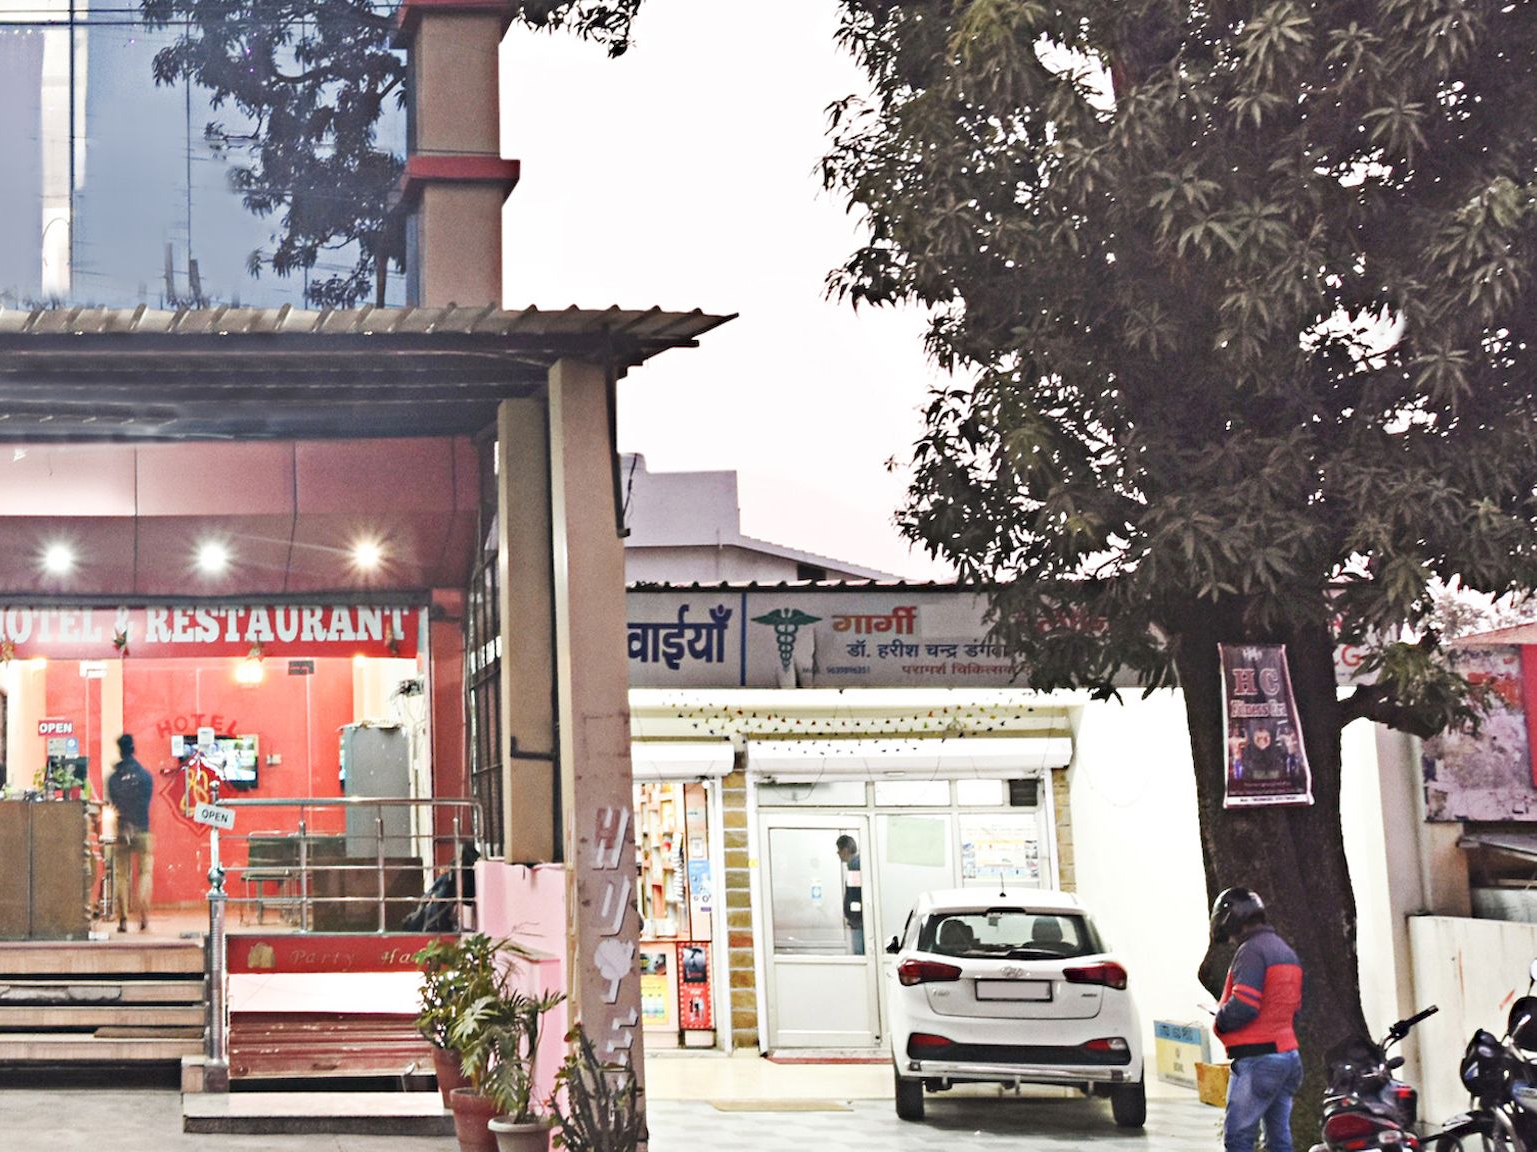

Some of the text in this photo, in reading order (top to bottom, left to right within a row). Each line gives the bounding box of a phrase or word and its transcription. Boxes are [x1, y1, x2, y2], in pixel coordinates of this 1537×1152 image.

[146, 606, 410, 643] RESTAURANT
[831, 606, 917, 634] गार्गी
[846, 639, 871, 658] डॉ.
[877, 638, 920, 659] हरीश
[925, 643, 958, 658] चन्द्र
[39, 722, 73, 734] OPEN
[156, 713, 238, 739] HOTEL
[201, 809, 229, 824] OPEN
[289, 948, 356, 969] Party
